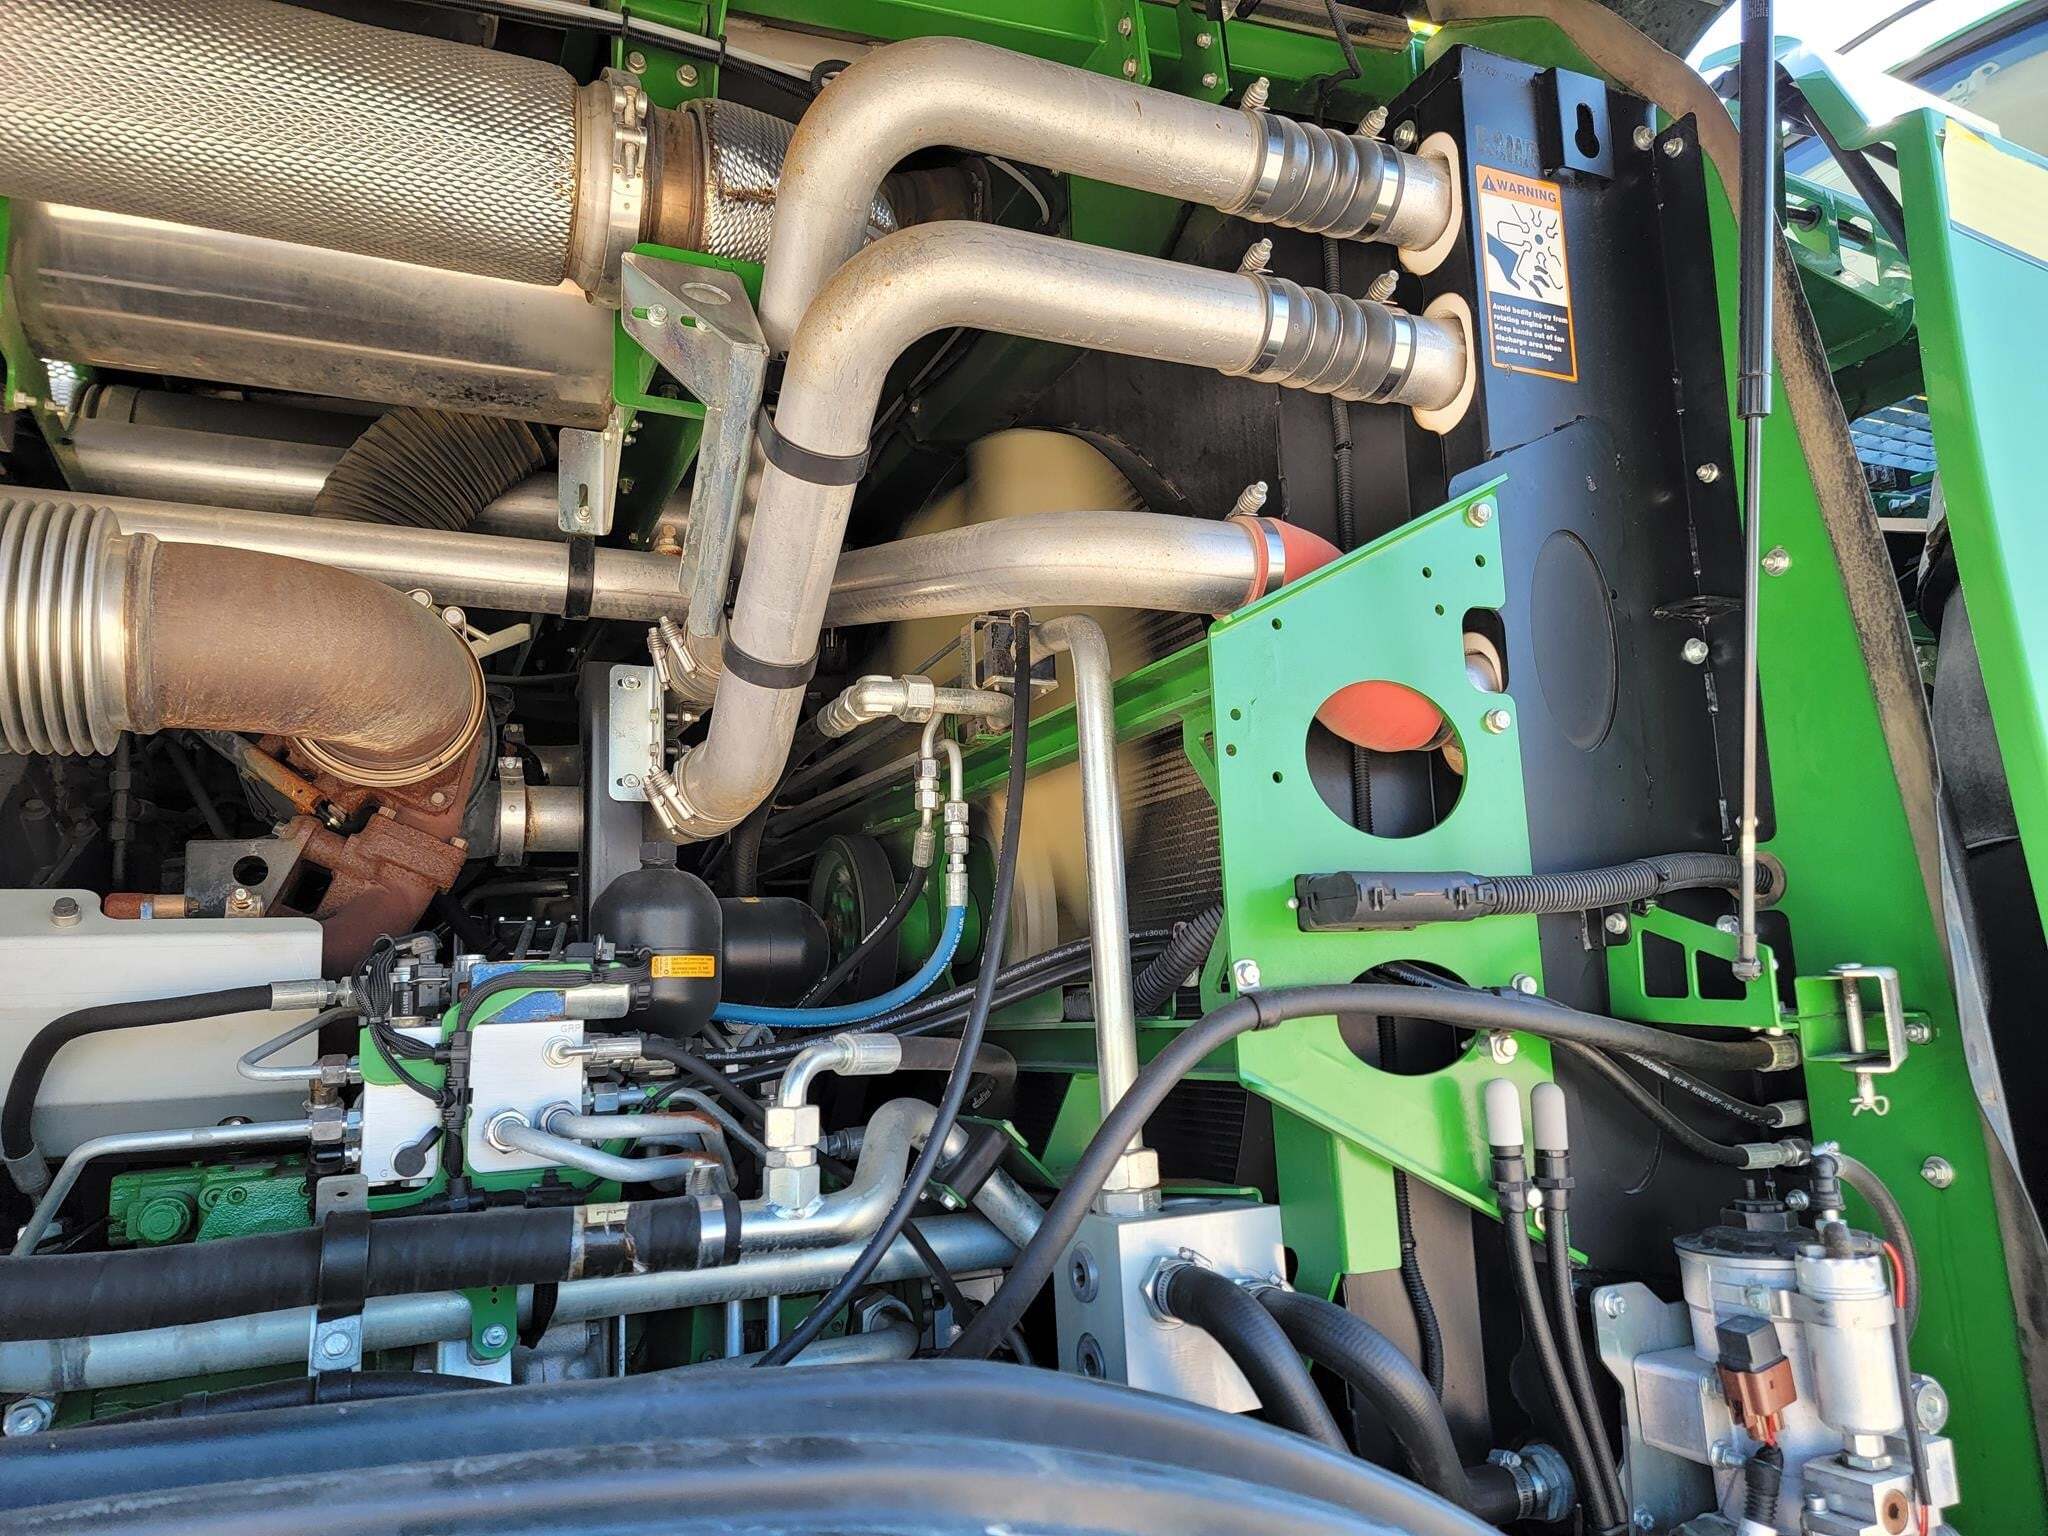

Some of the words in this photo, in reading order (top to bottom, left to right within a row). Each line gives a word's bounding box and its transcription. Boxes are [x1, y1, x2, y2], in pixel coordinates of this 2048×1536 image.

[1497, 179, 1557, 202] WARNING
[1492, 303, 1511, 312] Avoid
[1512, 306, 1532, 317] bodily
[1533, 311, 1552, 322] injury
[1553, 315, 1568, 324] from
[1493, 314, 1519, 325] rotating
[1521, 319, 1542, 329] engine
[1544, 323, 1557, 332] fan.
[1494, 323, 1511, 333] Keep
[1513, 327, 1532, 337] hands
[1495, 334, 1527, 346] discharge
[1529, 341, 1543, 349] area
[1545, 343, 1562, 352] when
[1496, 345, 1518, 354] engine
[1520, 348, 1526, 356] is
[1527, 350, 1554, 362] running.
